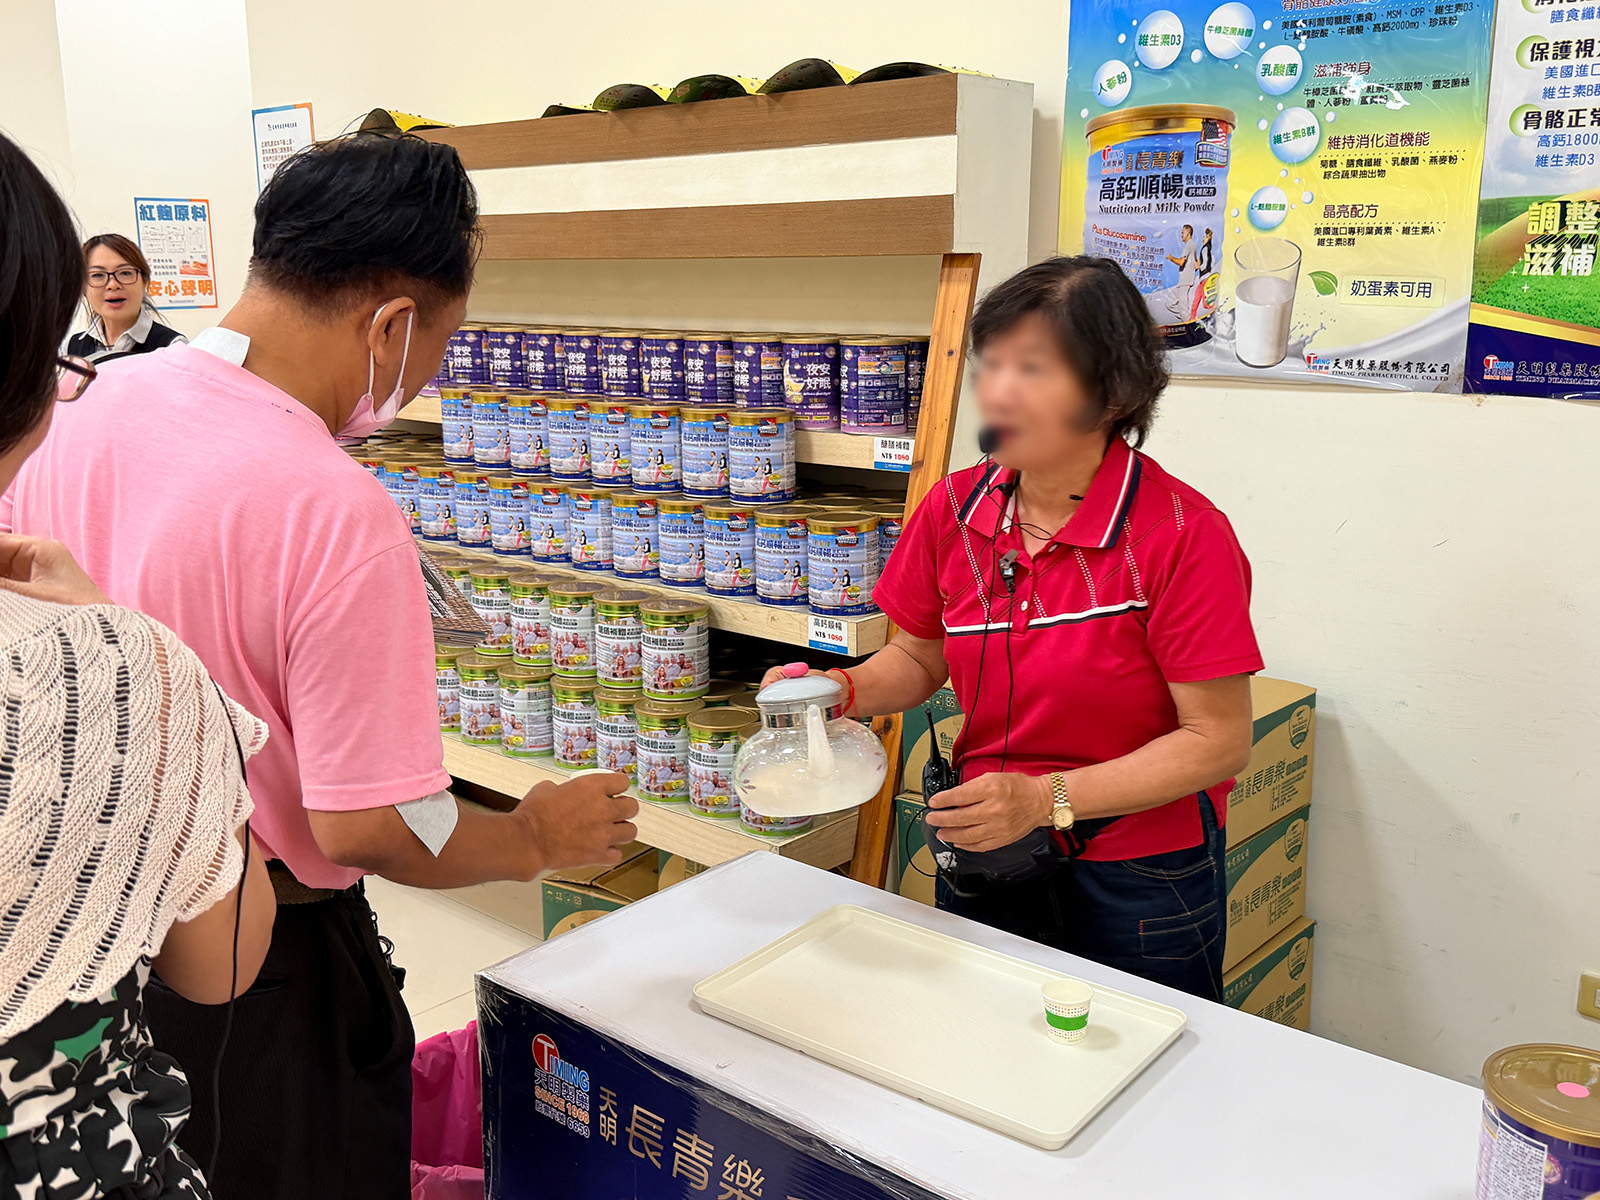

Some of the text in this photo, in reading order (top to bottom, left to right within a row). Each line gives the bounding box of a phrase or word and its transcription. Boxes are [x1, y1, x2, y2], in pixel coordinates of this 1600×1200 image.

[1550, 6, 1600, 23] 膳食纖
[1138, 34, 1182, 47] 維生素D3
[1530, 38, 1600, 62] 保護視
[1260, 63, 1298, 77] 乳酸菌
[1272, 126, 1316, 145] 維生素B群
[1327, 131, 1430, 150] 維持消化道機能
[1537, 133, 1600, 148] 高鈣1800
[1535, 153, 1595, 168] 維生素D3
[1099, 174, 1184, 202] 高鈣順暢
[1098, 200, 1216, 216] Nutritional Milk Powder
[1323, 204, 1379, 219] 晶亮配方
[1527, 201, 1600, 235] 調整
[1317, 237, 1356, 247] 維生素B群
[1522, 243, 1597, 277] 滋補
[147, 279, 214, 297] 安心聲明
[1350, 280, 1433, 298] 奶蛋素可用
[607, 354, 628, 366] 夜安
[650, 356, 672, 369] 夜安
[607, 366, 629, 378] 好眠
[650, 368, 673, 381] 好眠
[805, 362, 831, 376] 夜安
[1357, 371, 1419, 380] PHARMACEUTICAL
[805, 376, 832, 390] 好眠
[894, 453, 910, 461] 1080
[827, 633, 843, 642] 1080
[1252, 757, 1286, 795] 長青樂
[1250, 872, 1282, 912] 長青樂
[532, 1033, 590, 1092] TIMING
[534, 1067, 590, 1112] 天明製藥
[534, 1085, 566, 1112] SINCE
[599, 1085, 619, 1147] 天明
[566, 1116, 591, 1139] 6659
[625, 1103, 766, 1200] 長青樂
